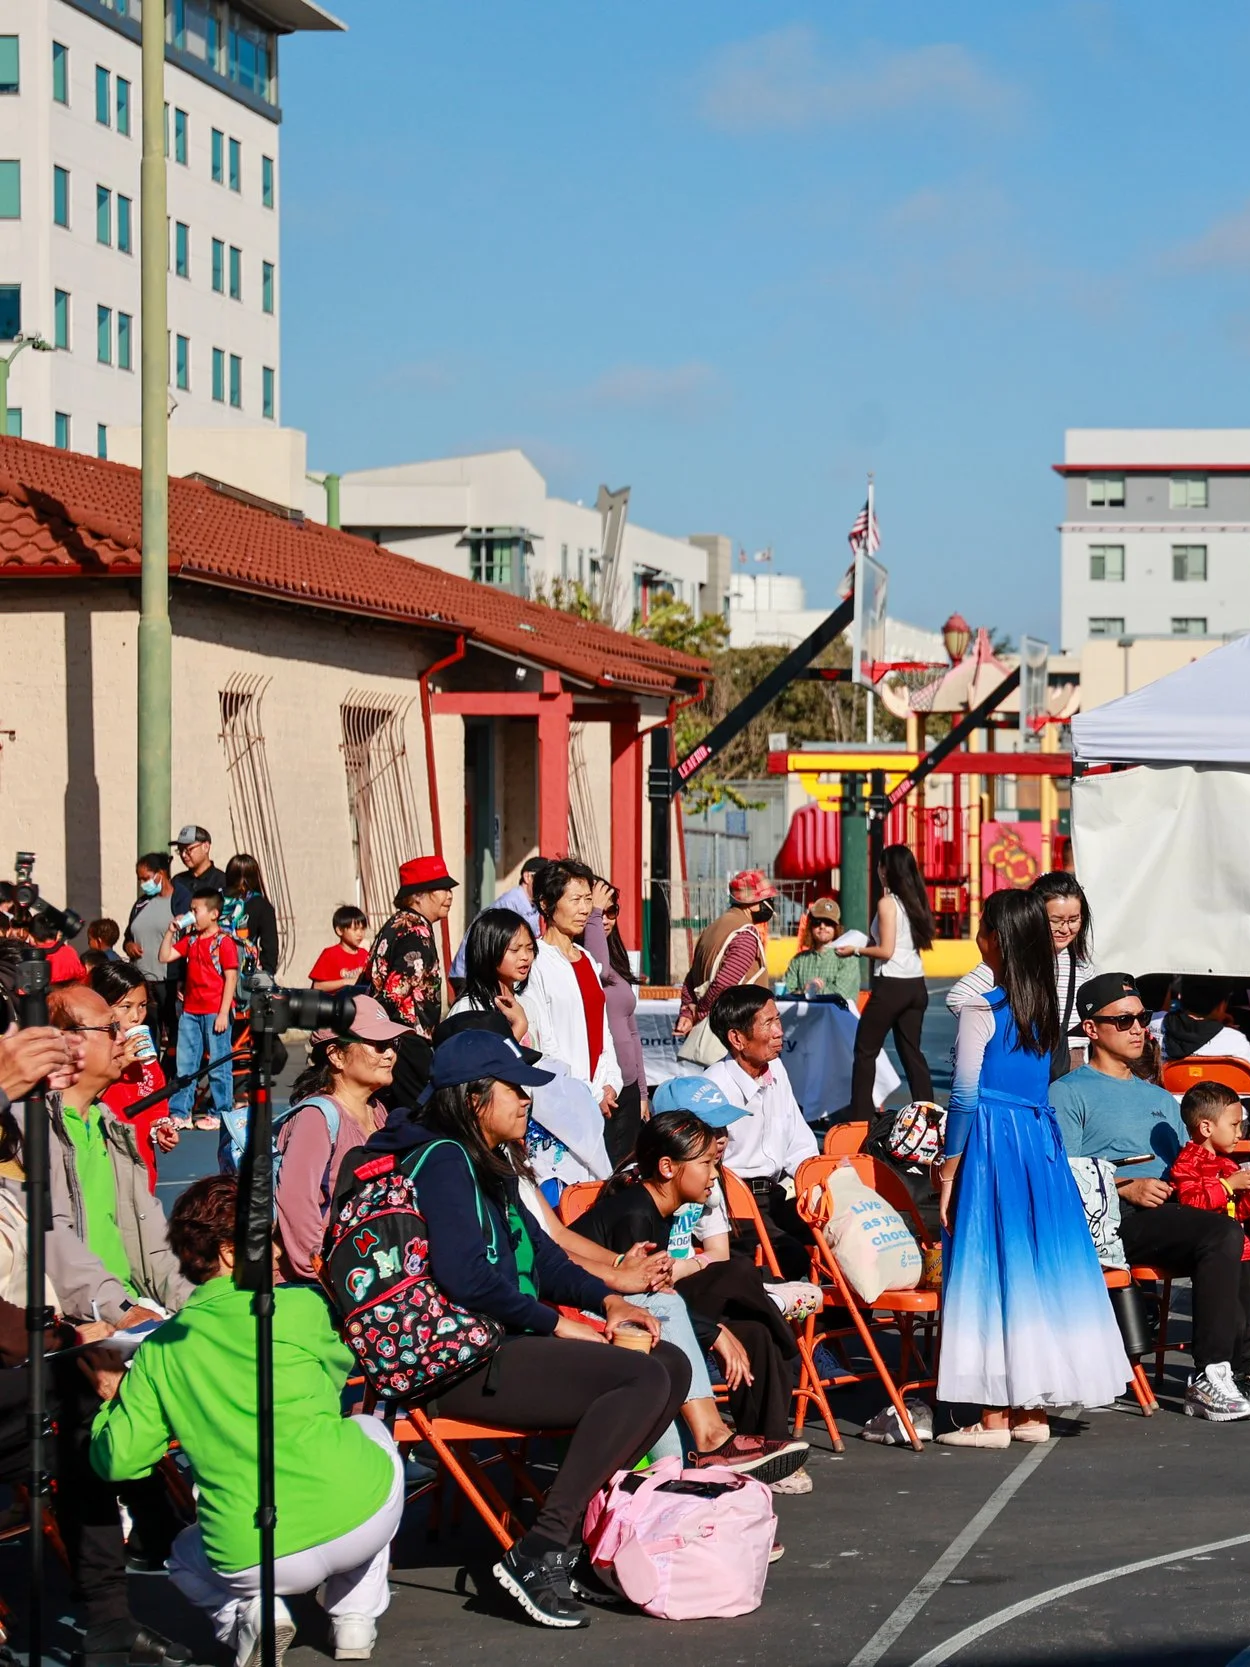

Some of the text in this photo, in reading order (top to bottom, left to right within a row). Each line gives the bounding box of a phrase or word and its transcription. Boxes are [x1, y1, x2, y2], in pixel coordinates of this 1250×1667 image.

[851, 1199, 881, 1215] Live
[862, 1218, 881, 1231] as
[372, 1245, 402, 1279] M
